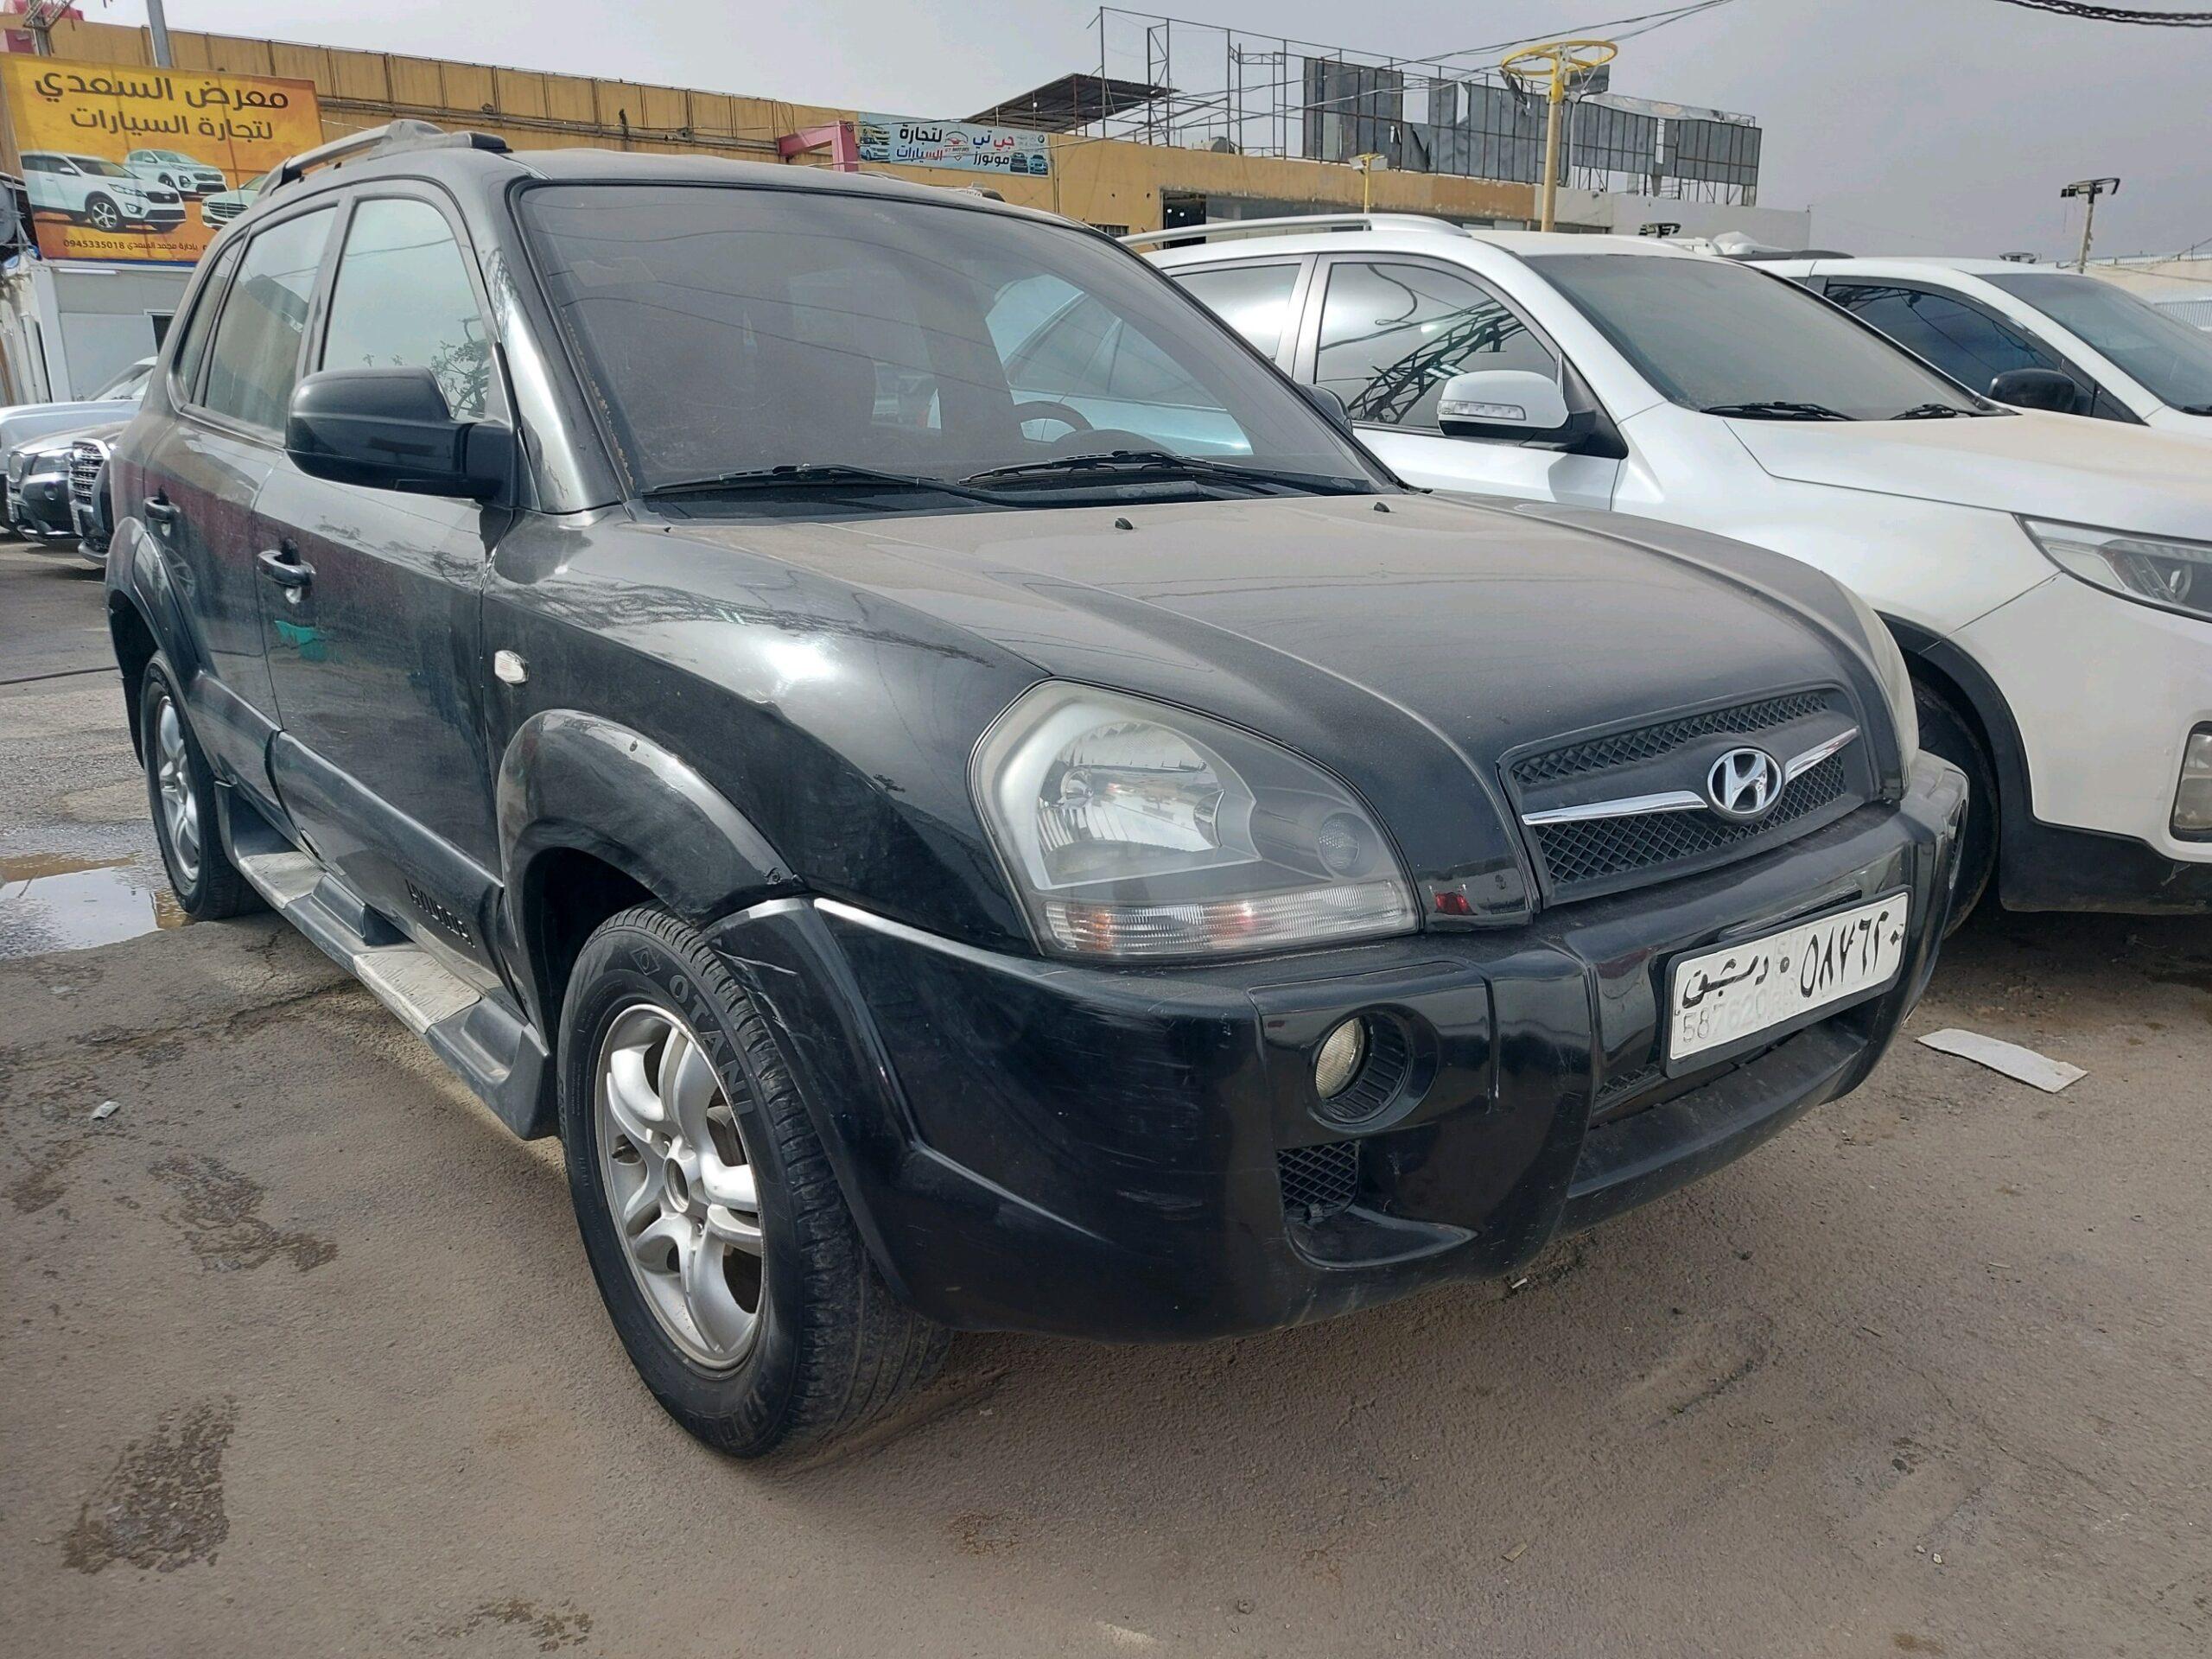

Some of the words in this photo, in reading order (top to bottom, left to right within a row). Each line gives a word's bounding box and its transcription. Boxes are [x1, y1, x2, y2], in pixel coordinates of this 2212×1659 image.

[35, 71, 174, 103] السعدي
[185, 80, 289, 110] معرض
[70, 107, 189, 137] السيارات
[198, 118, 273, 143] لتجارة
[899, 124, 943, 144] لتجارة
[973, 130, 992, 149] تي
[993, 135, 1015, 153] جي
[896, 145, 944, 162] السيارات
[973, 150, 1010, 168] موتورز
[63, 239, 125, 250] 0945335018
[669, 975, 753, 1116] OTANI
